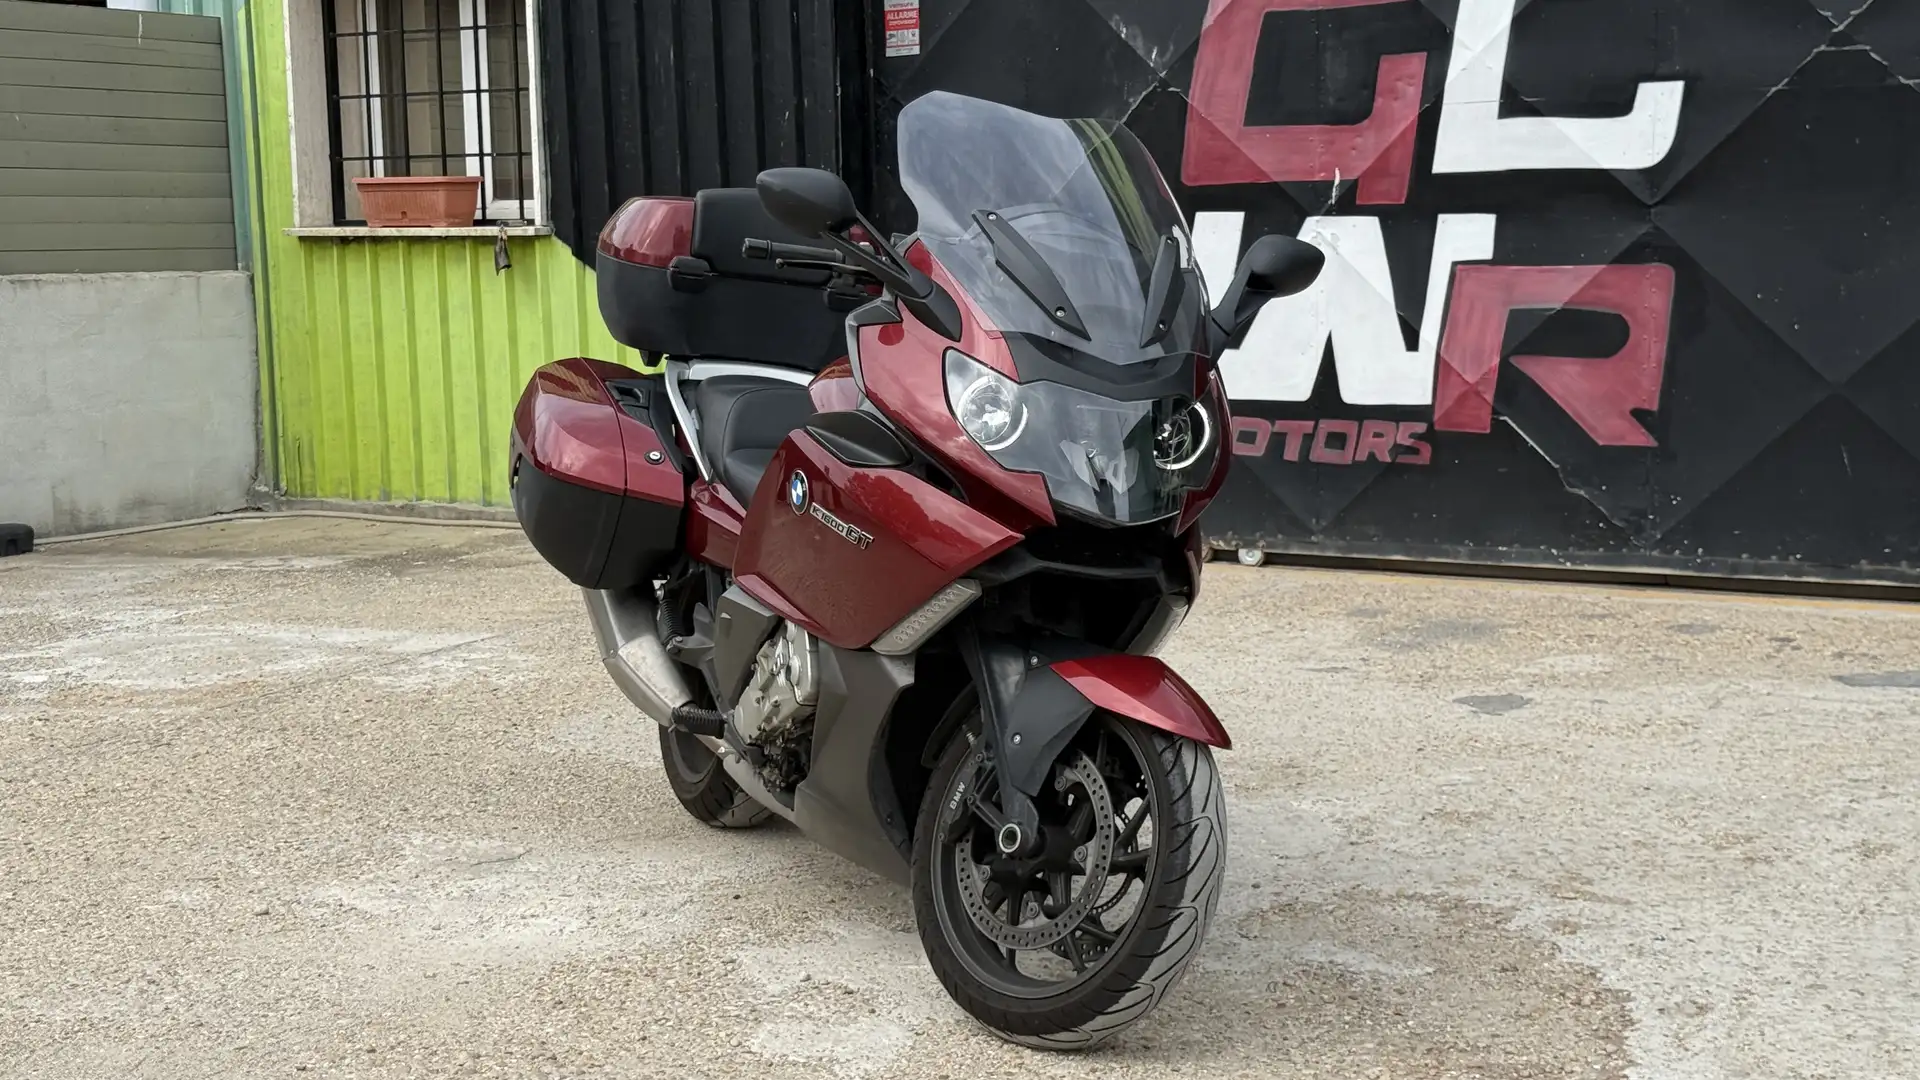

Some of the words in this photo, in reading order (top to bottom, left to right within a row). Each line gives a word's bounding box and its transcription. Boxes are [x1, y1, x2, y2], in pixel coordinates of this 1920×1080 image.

[887, 10, 918, 20] ALLARME
[1230, 415, 1433, 466] OTORS
[949, 781, 966, 810] BMW
